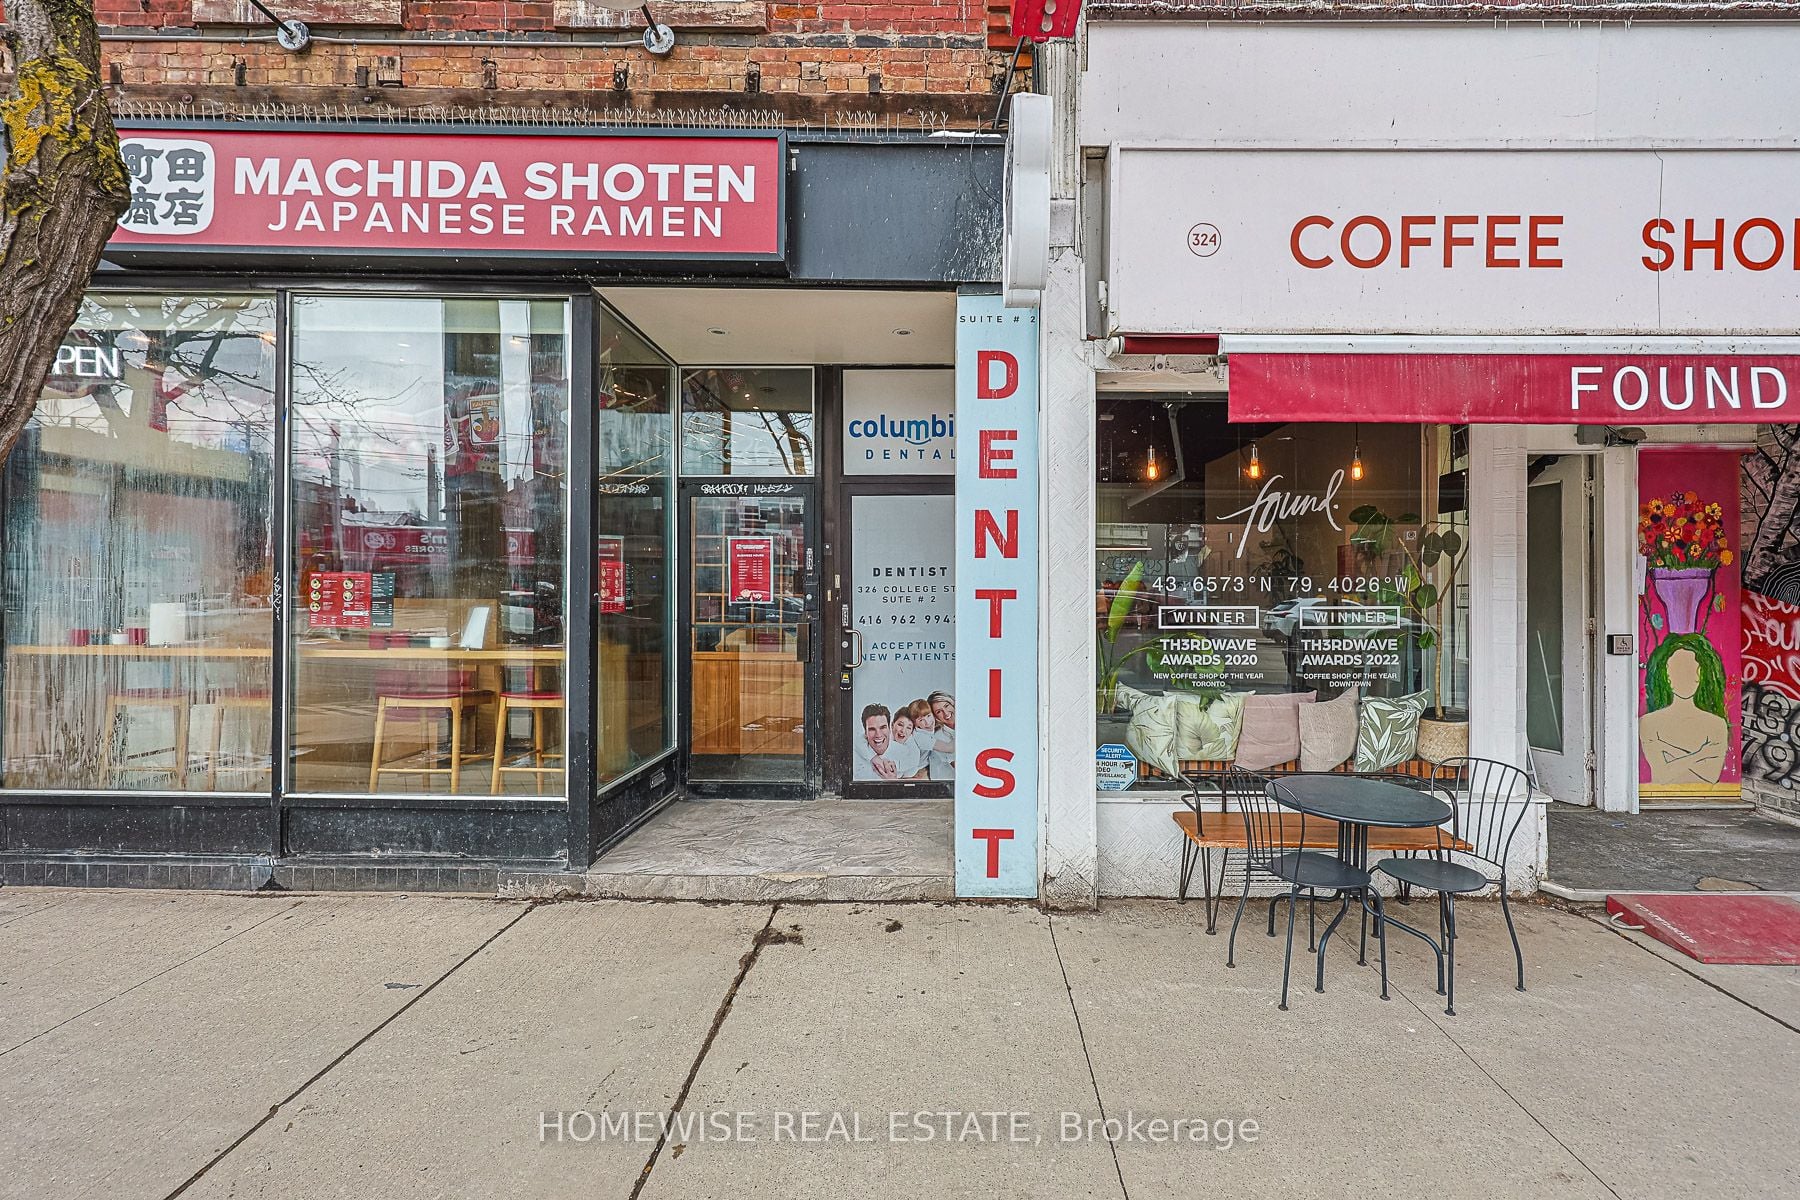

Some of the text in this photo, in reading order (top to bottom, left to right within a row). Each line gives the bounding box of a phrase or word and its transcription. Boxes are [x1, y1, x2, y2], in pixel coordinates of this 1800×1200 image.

[234, 157, 756, 203] MACHIDA SHOTEN
[267, 201, 722, 238] JAPANESE RAMEN
[1192, 233, 1217, 246] 324
[1290, 215, 1800, 272] COFFEE SHO
[53, 345, 119, 378] PEN
[1571, 365, 1788, 411] FOUND
[848, 414, 954, 441] columbi
[866, 449, 956, 460] DENTAL
[872, 567, 948, 577] DENTIST
[1152, 576, 1408, 592] 43.6573°N 79.4026°W
[858, 615, 882, 624] 416
[891, 615, 916, 624] 962
[972, 350, 1019, 878] DENTIST
[1173, 612, 1246, 623] WINNER
[1314, 612, 1387, 623] WINNER
[872, 642, 946, 650] ACCEPTING
[1159, 638, 1257, 651] TH3RDWAVE
[1301, 638, 1398, 651] TH3RDWAVE
[1159, 654, 1258, 666] AWARDS 2020
[1301, 654, 1400, 666] AWARDS 2022
